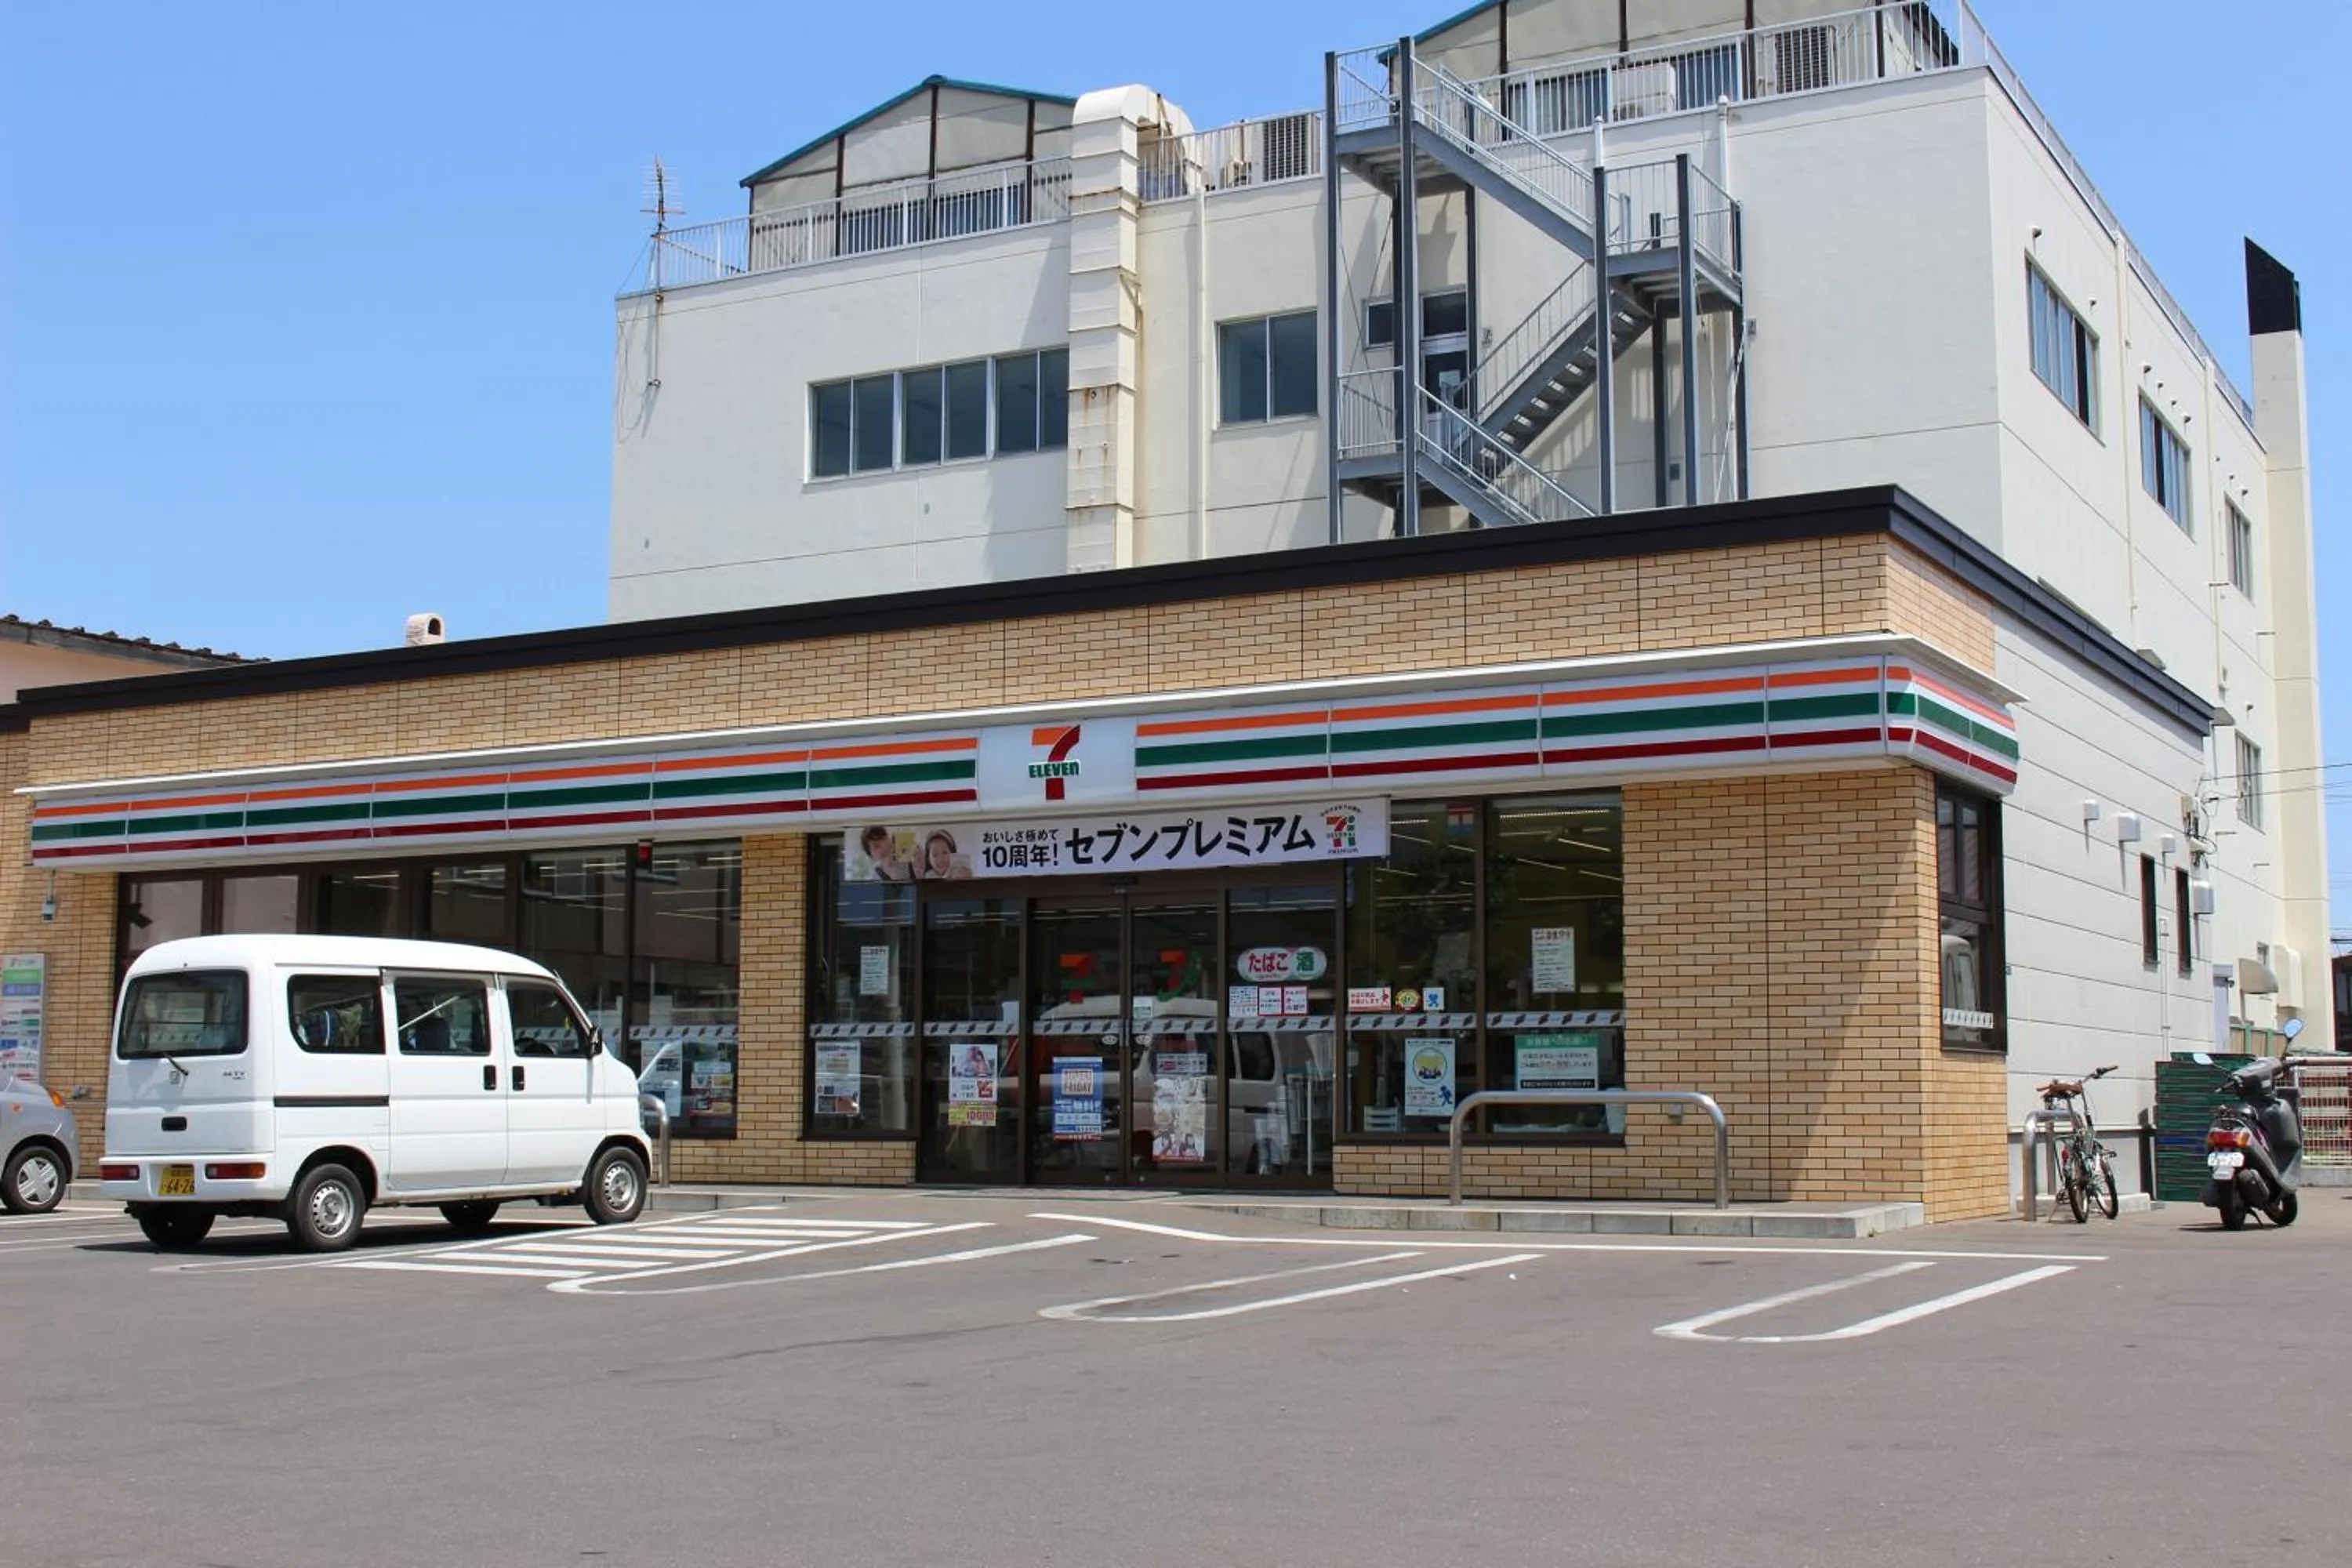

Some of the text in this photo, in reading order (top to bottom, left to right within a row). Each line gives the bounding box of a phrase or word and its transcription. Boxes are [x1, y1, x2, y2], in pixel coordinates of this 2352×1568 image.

[1032, 724, 1080, 800] 7
[982, 829, 1059, 844] おいしさ極めて
[1065, 815, 1317, 865] セブンプレミアム
[982, 843, 1059, 868] 10周年!
[1248, 952, 1314, 972] たばこ 酒
